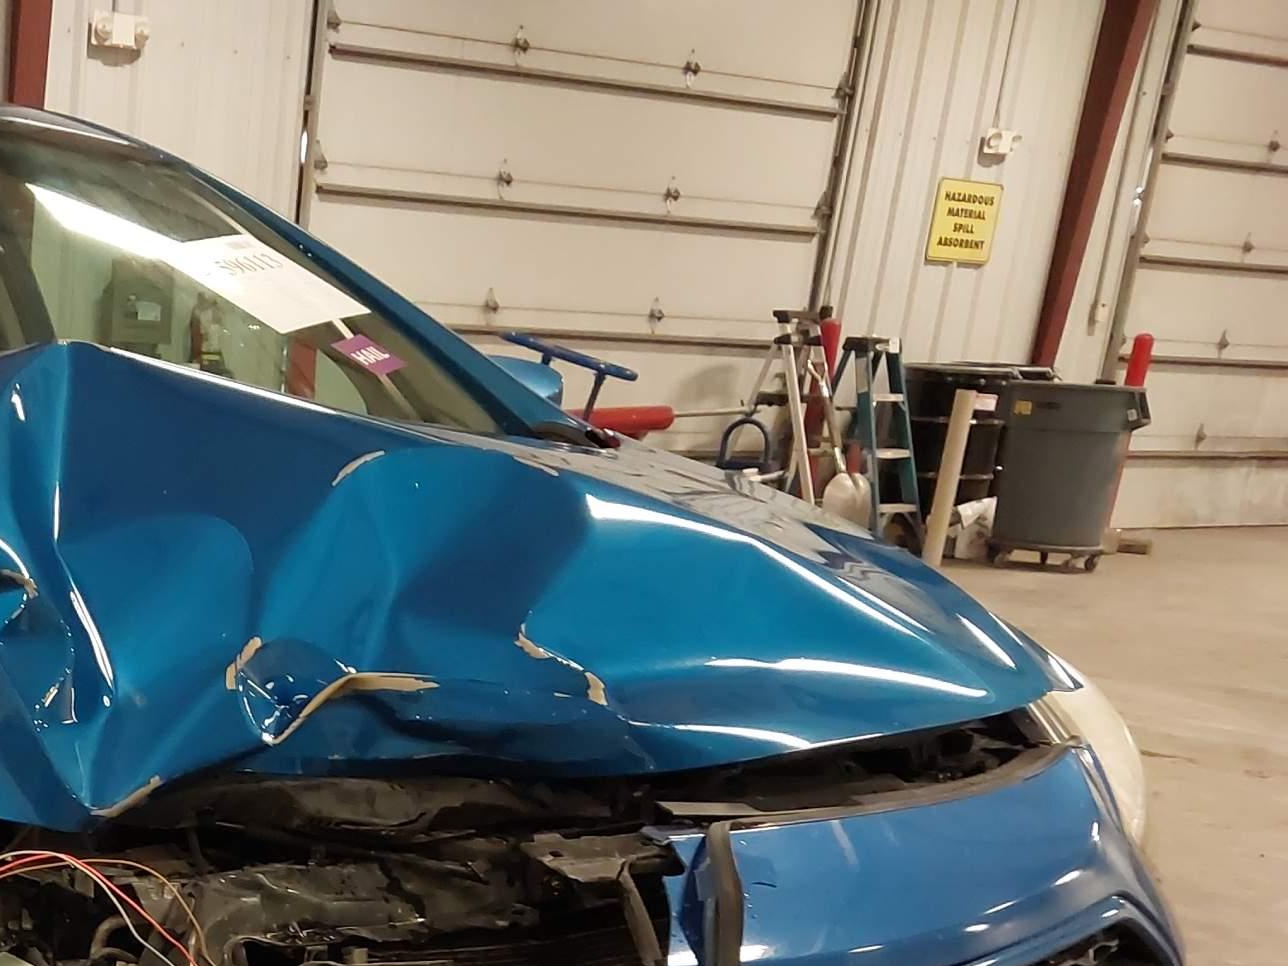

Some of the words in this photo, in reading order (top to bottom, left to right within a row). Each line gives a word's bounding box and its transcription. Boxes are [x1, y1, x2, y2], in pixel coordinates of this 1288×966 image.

[945, 191, 995, 206] HAZARDOUS
[947, 207, 986, 221] MATERIAL
[952, 222, 974, 234] SPILL
[937, 236, 985, 250] ABSORBENT
[350, 346, 391, 366] HAIL
